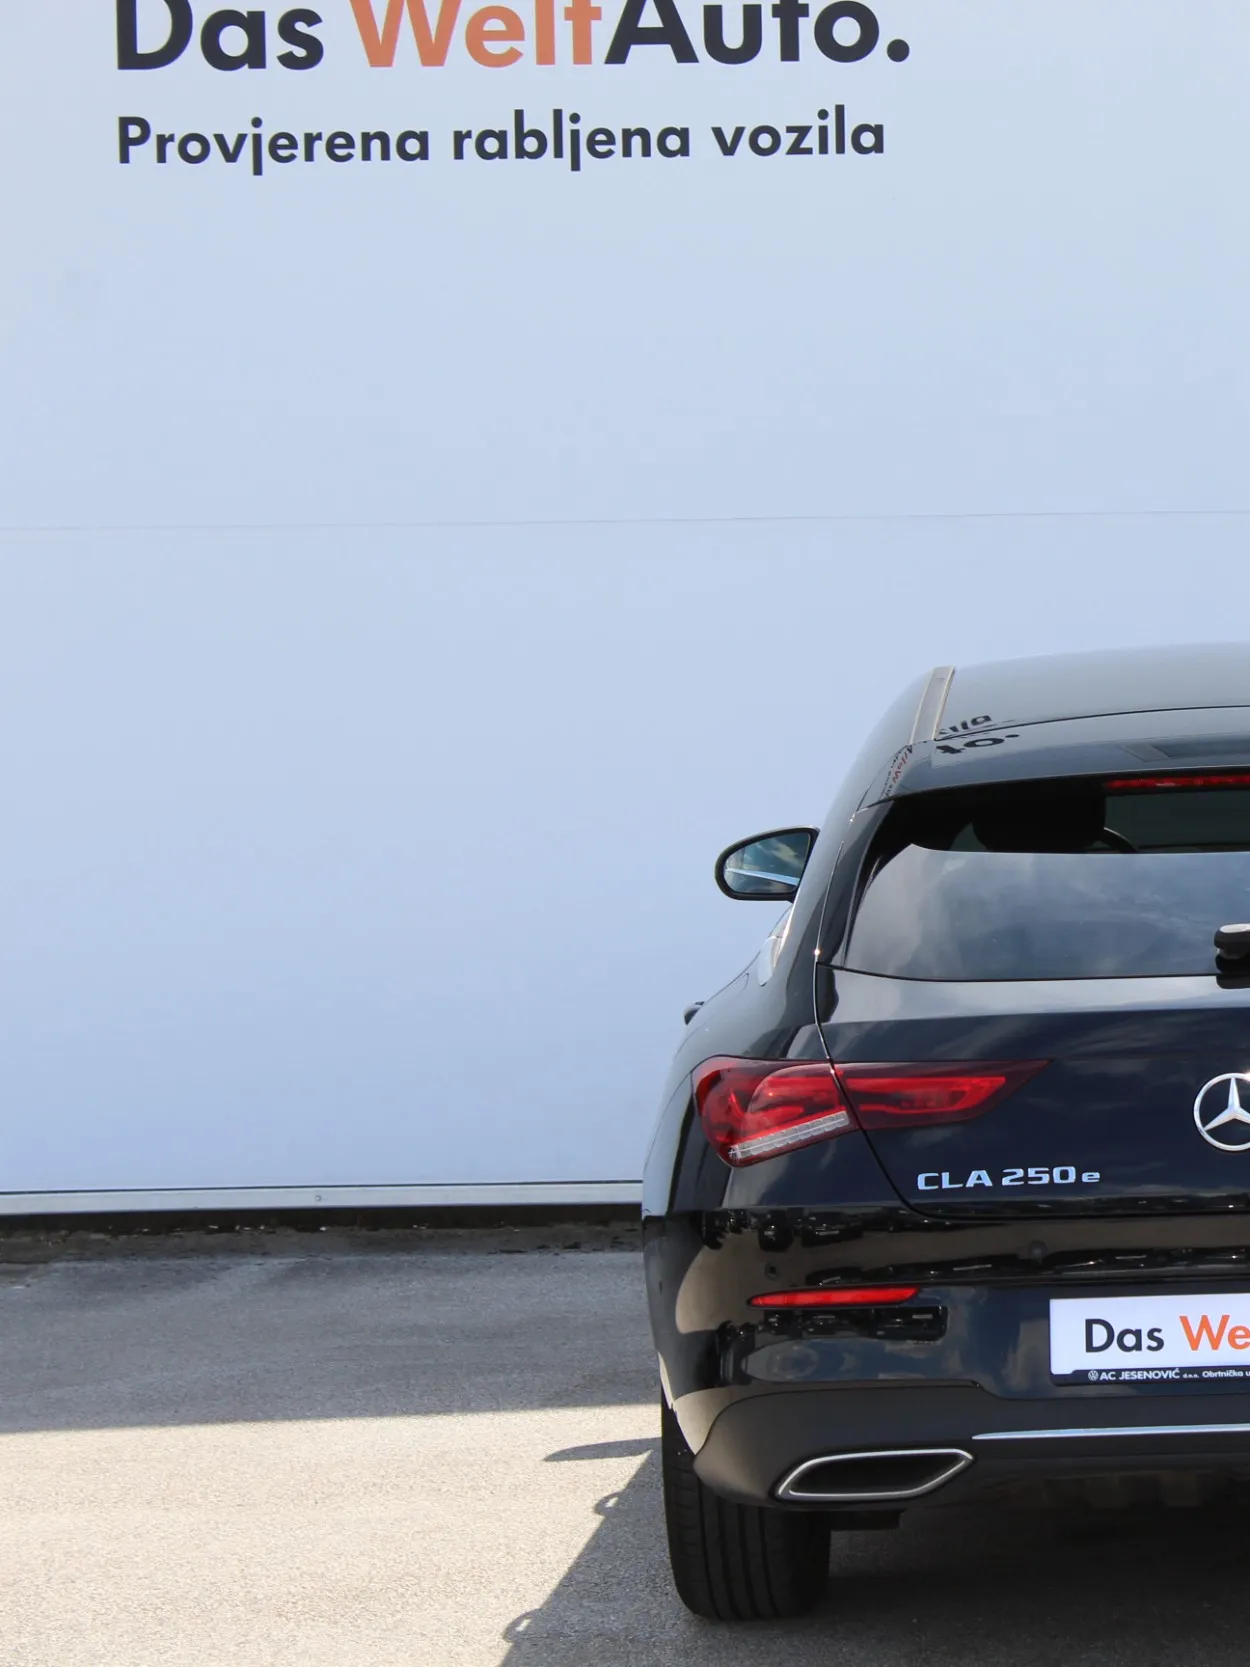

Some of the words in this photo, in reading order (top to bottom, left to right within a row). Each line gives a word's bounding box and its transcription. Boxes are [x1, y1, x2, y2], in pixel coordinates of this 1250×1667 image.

[116, 0, 324, 71] Das
[350, 0, 910, 67] WeltAuto.
[118, 116, 430, 177] Provjerena
[453, 108, 690, 172] rabljena
[711, 104, 885, 157] vozila
[917, 1169, 993, 1191] CLA
[1085, 1318, 1165, 1353] Das
[1100, 1371, 1117, 1381] AC
[1119, 1368, 1181, 1381] JESENOVIĆ
[1202, 1368, 1244, 1378] Obrtnička
